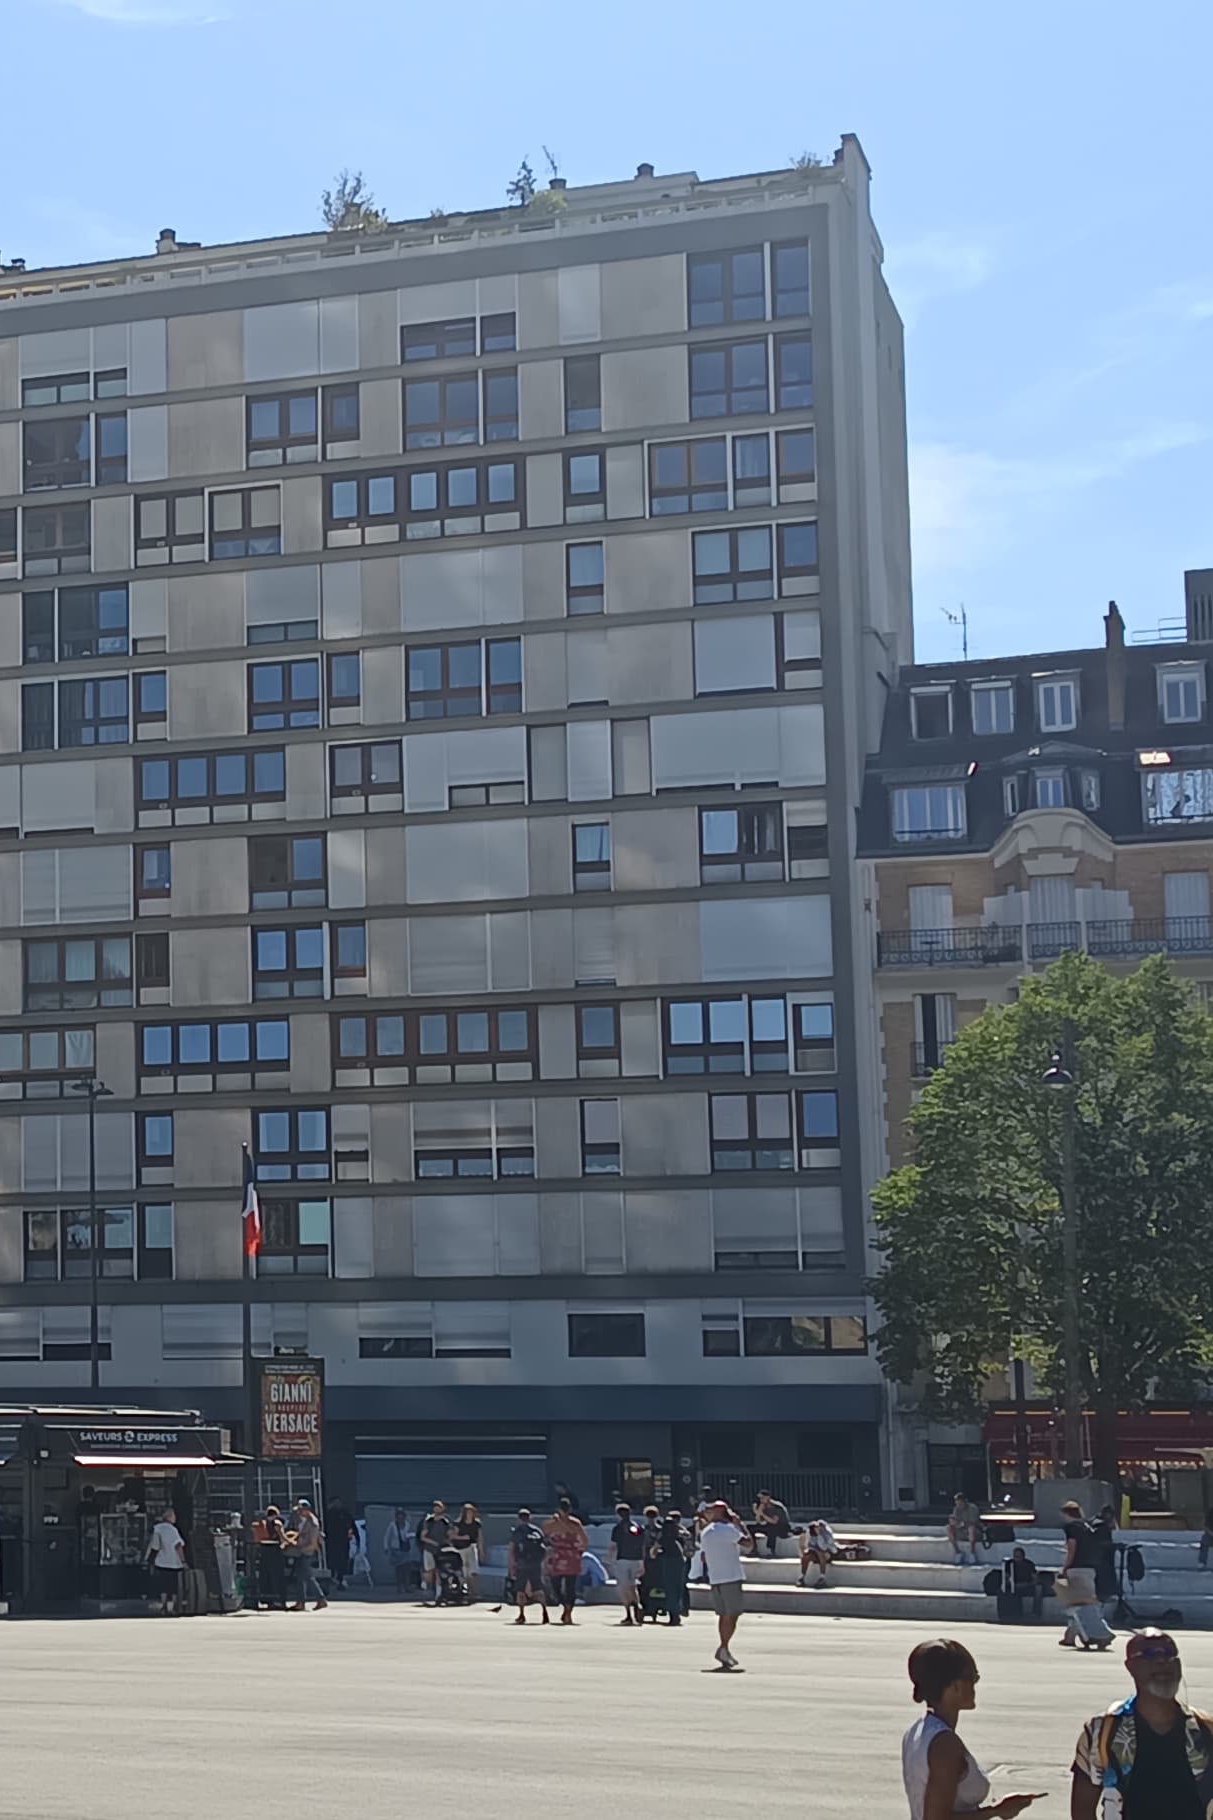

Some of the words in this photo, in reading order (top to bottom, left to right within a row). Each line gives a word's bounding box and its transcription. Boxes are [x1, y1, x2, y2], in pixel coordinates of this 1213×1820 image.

[270, 1383, 312, 1403] GIANNI
[265, 1413, 319, 1433] VERSACE
[79, 1432, 122, 1442] SAVEURS
[136, 1432, 178, 1443] EXPRESS
